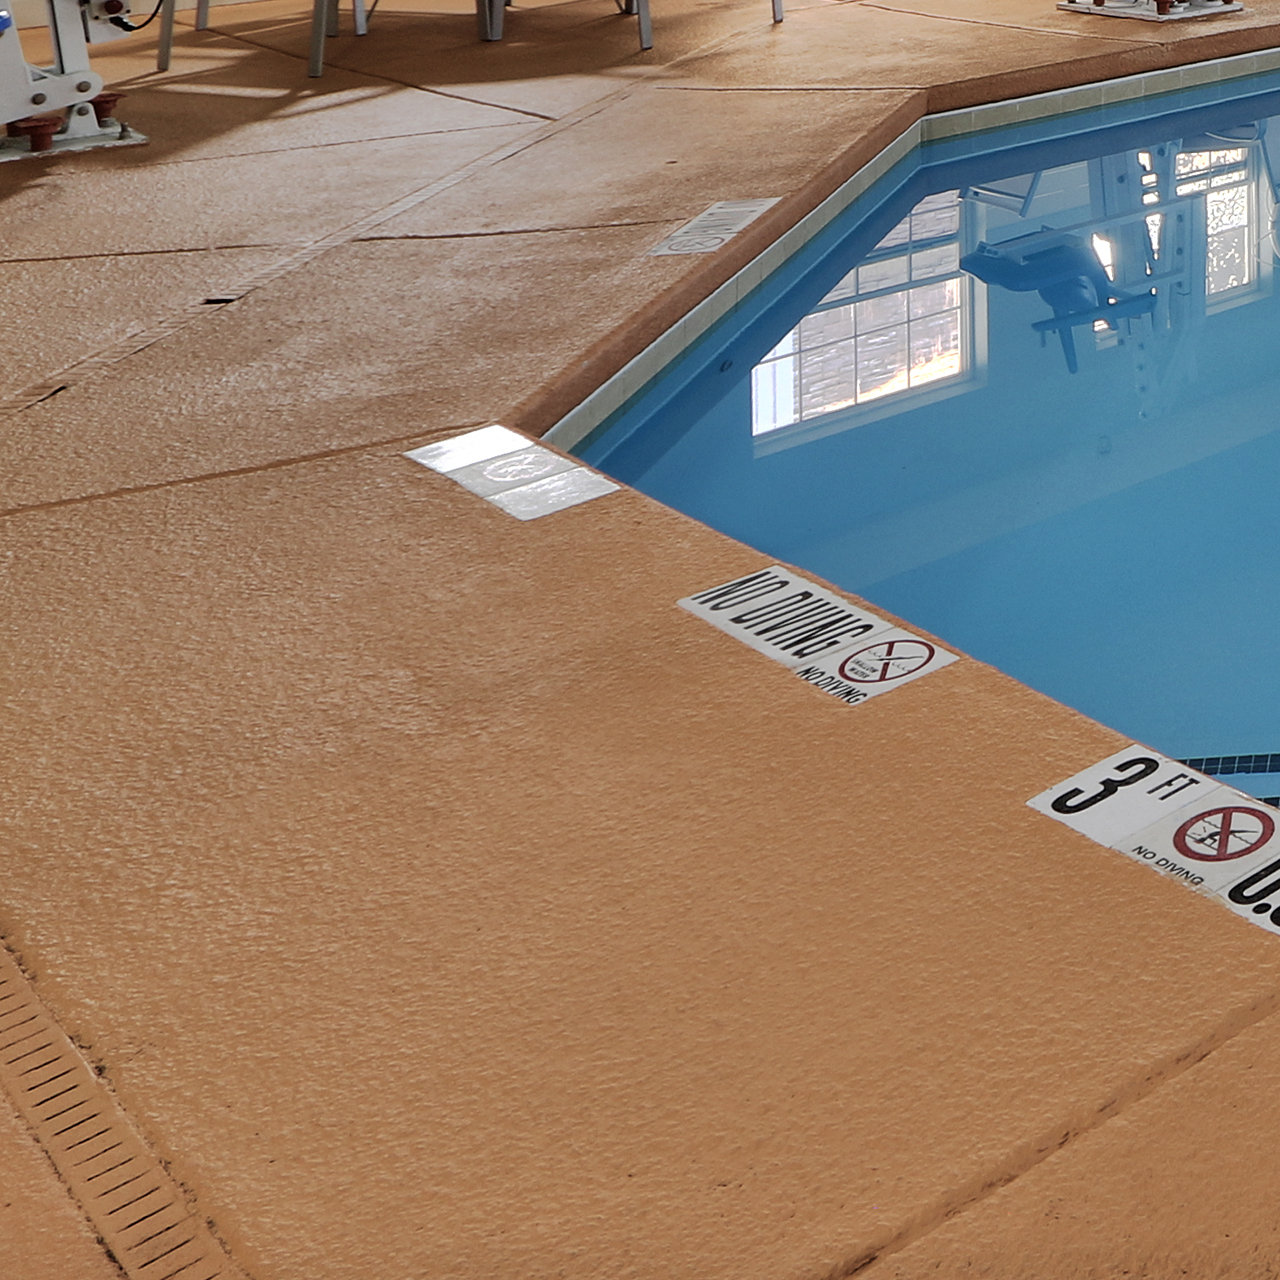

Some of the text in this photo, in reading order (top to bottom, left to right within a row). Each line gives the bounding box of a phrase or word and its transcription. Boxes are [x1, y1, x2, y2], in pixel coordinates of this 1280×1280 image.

[691, 571, 874, 659] NO DIVING
[796, 666, 868, 704] NO DIVING
[1051, 757, 1200, 815] 3 FT
[1132, 845, 1205, 885] NO DIVING
